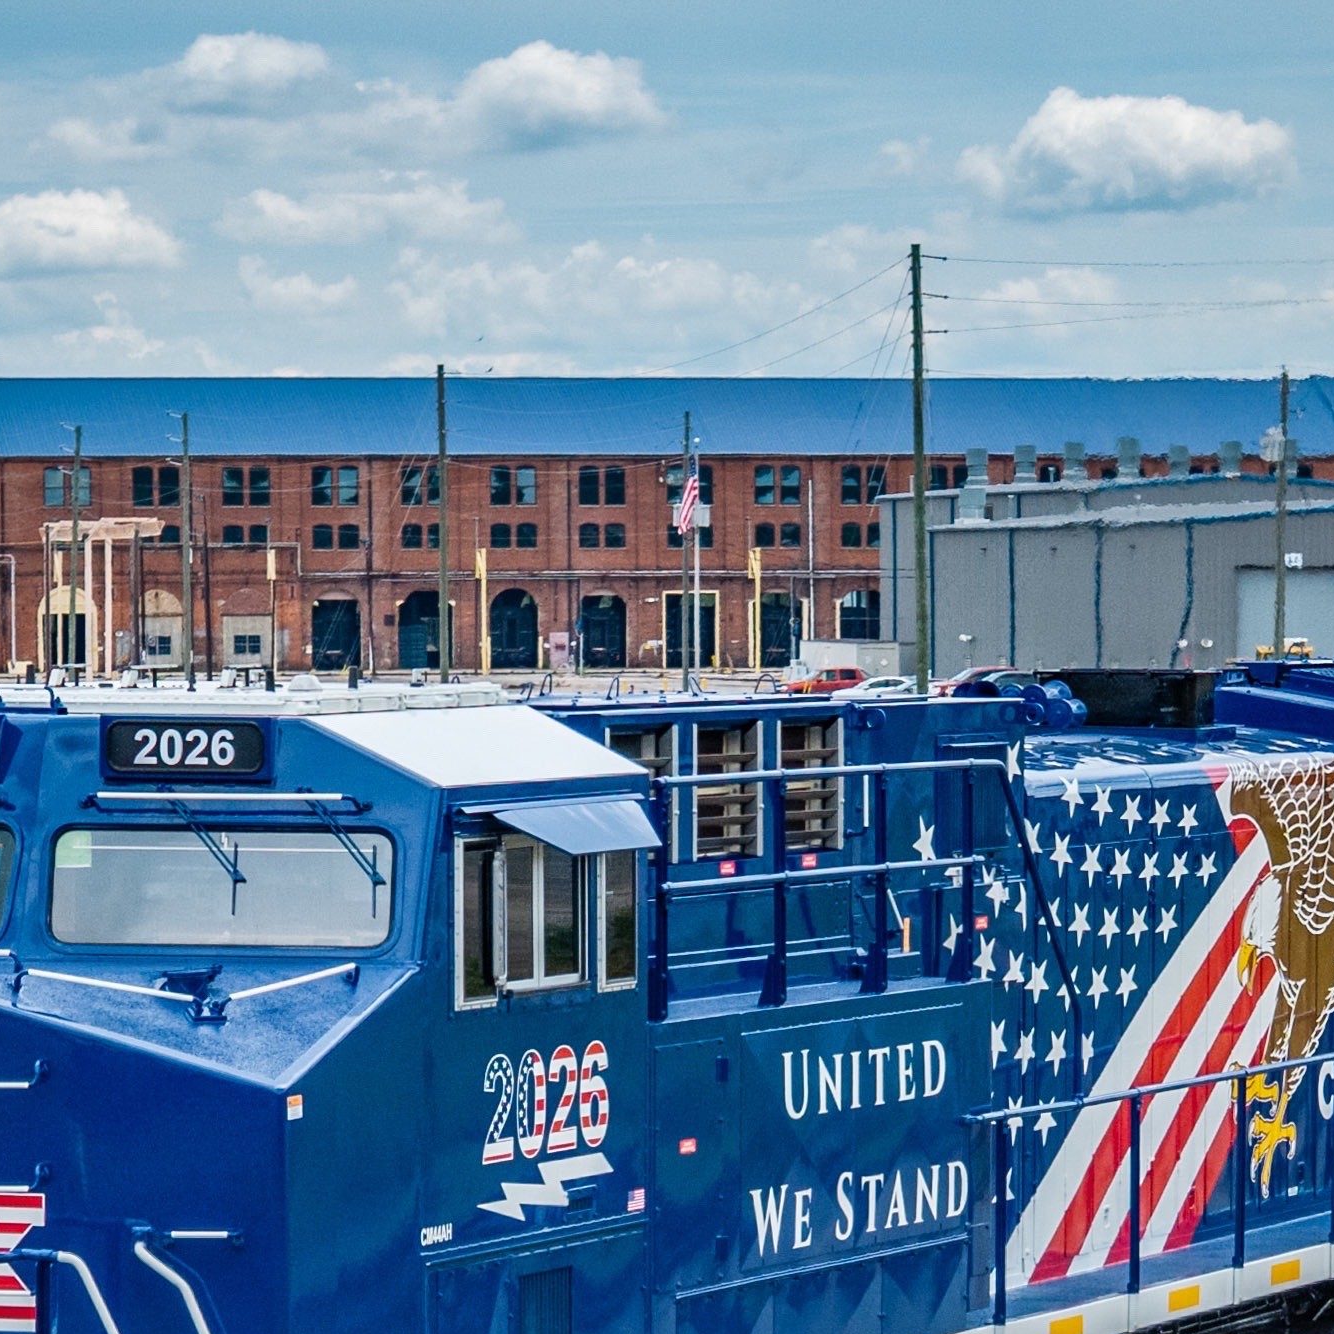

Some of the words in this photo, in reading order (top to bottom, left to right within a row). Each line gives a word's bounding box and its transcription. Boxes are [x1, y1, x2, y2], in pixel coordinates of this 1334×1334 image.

[133, 728, 235, 767] 2026
[482, 1040, 609, 1165] 2026
[781, 1039, 947, 1120] UNITED
[749, 1184, 813, 1258] WE
[834, 1160, 969, 1241] STAND
